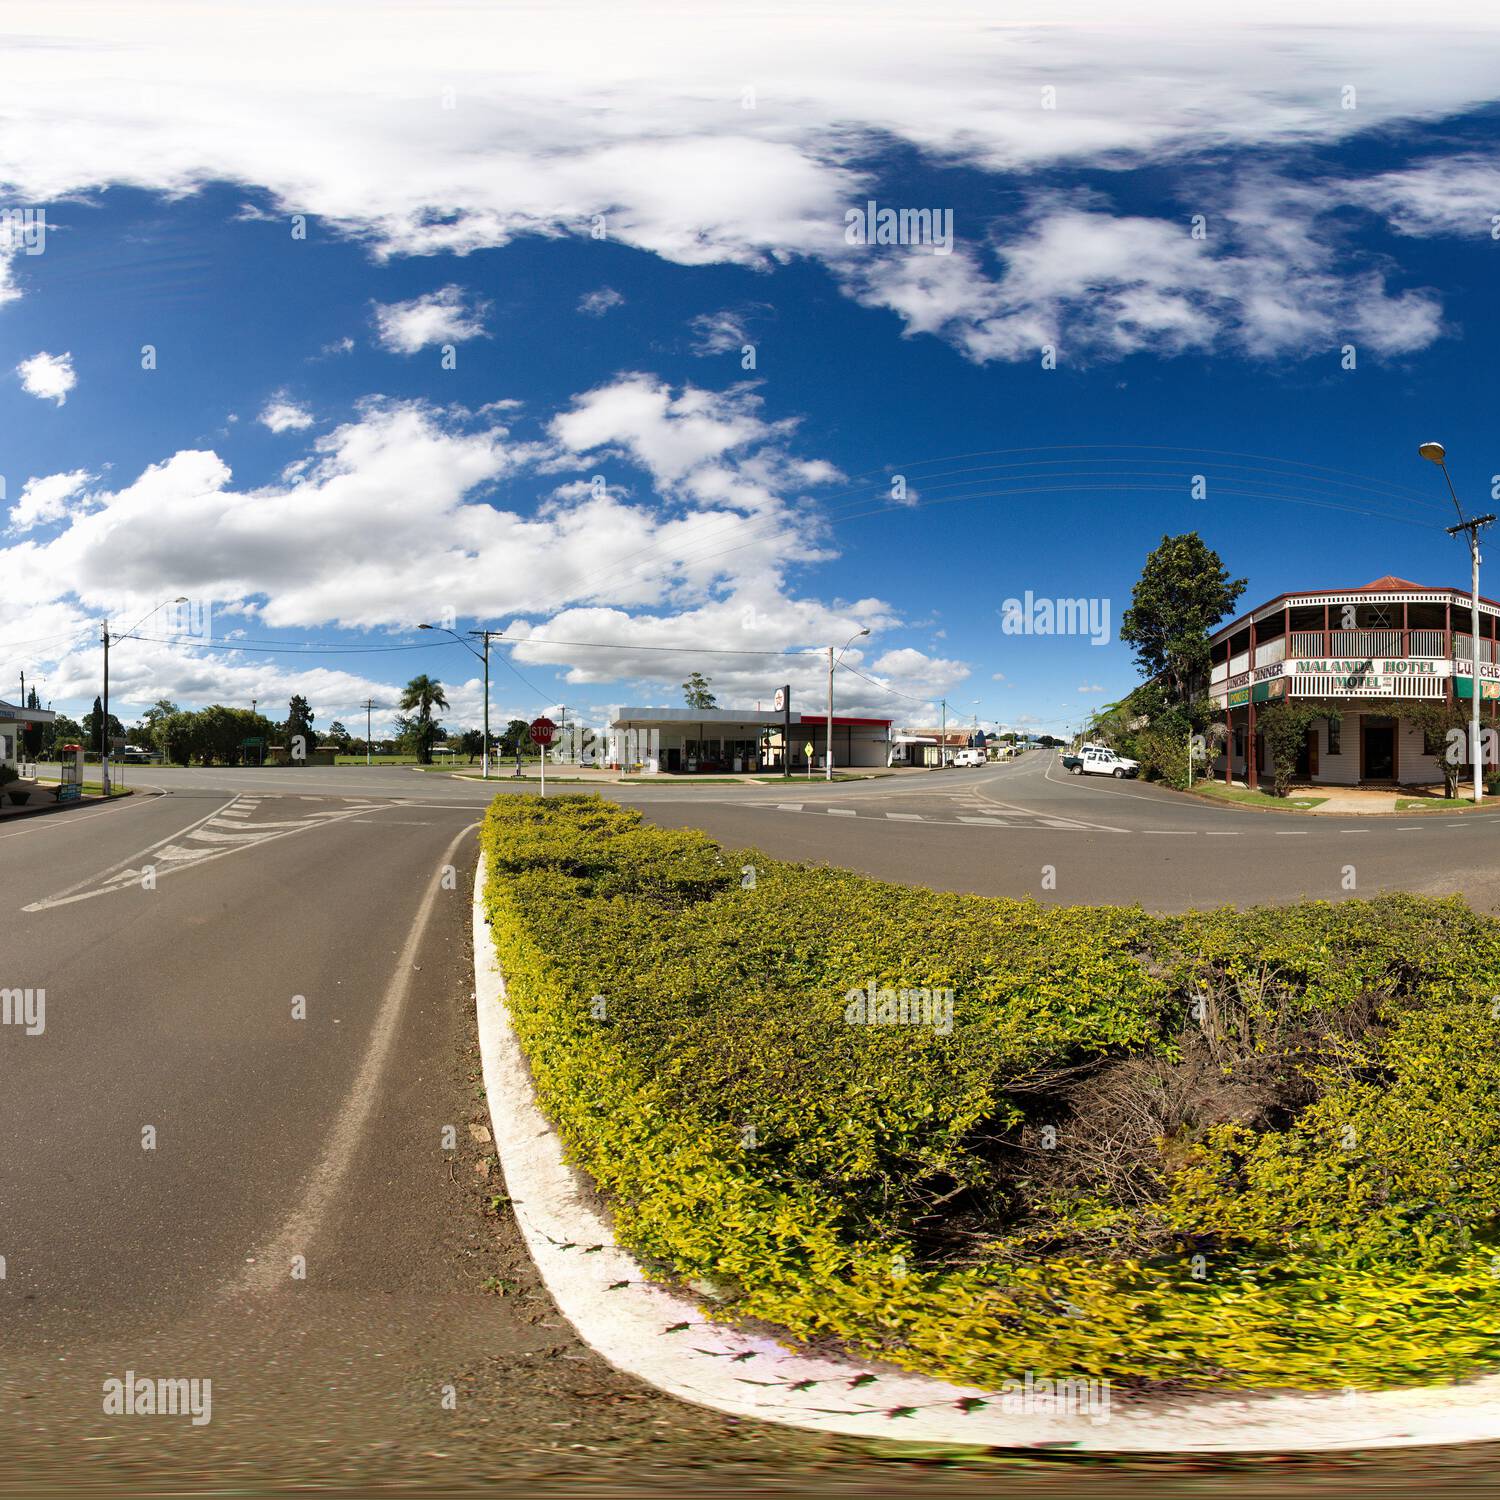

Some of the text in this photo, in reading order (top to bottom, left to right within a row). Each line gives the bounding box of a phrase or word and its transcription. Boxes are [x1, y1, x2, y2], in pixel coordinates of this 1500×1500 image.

[1296, 661, 1438, 675] MALANDA HOTEL
[1334, 677, 1381, 690] MOTEL
[531, 726, 555, 737] STOP
